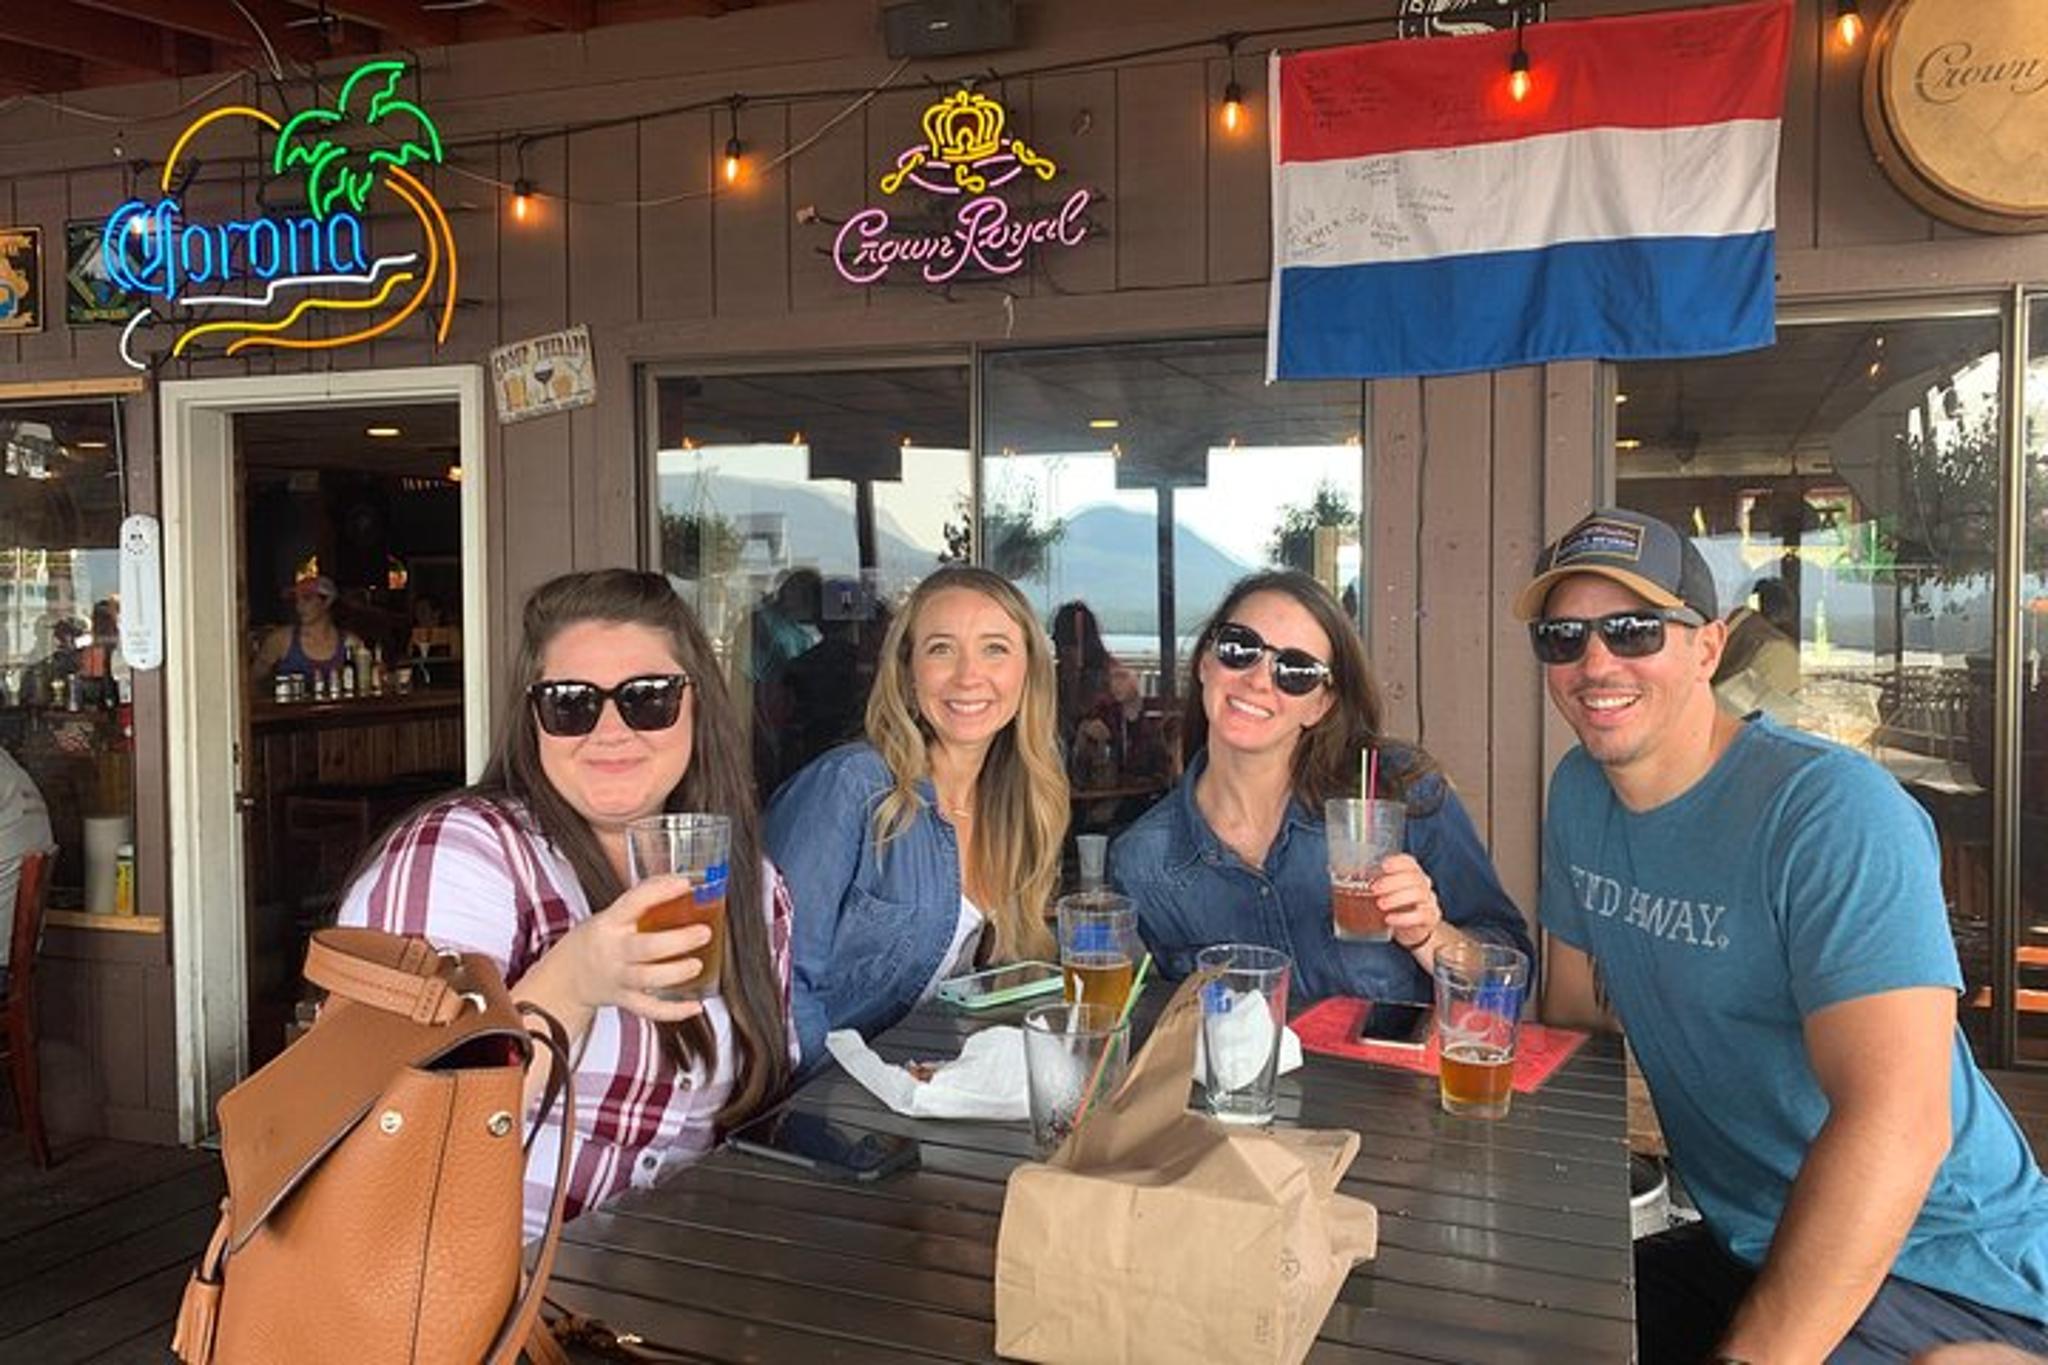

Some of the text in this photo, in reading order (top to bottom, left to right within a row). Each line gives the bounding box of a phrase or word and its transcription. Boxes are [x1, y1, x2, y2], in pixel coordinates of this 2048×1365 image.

[1914, 43, 2040, 104] Crown
[102, 198, 366, 299] Corona
[833, 189, 1090, 283] Crown Royal
